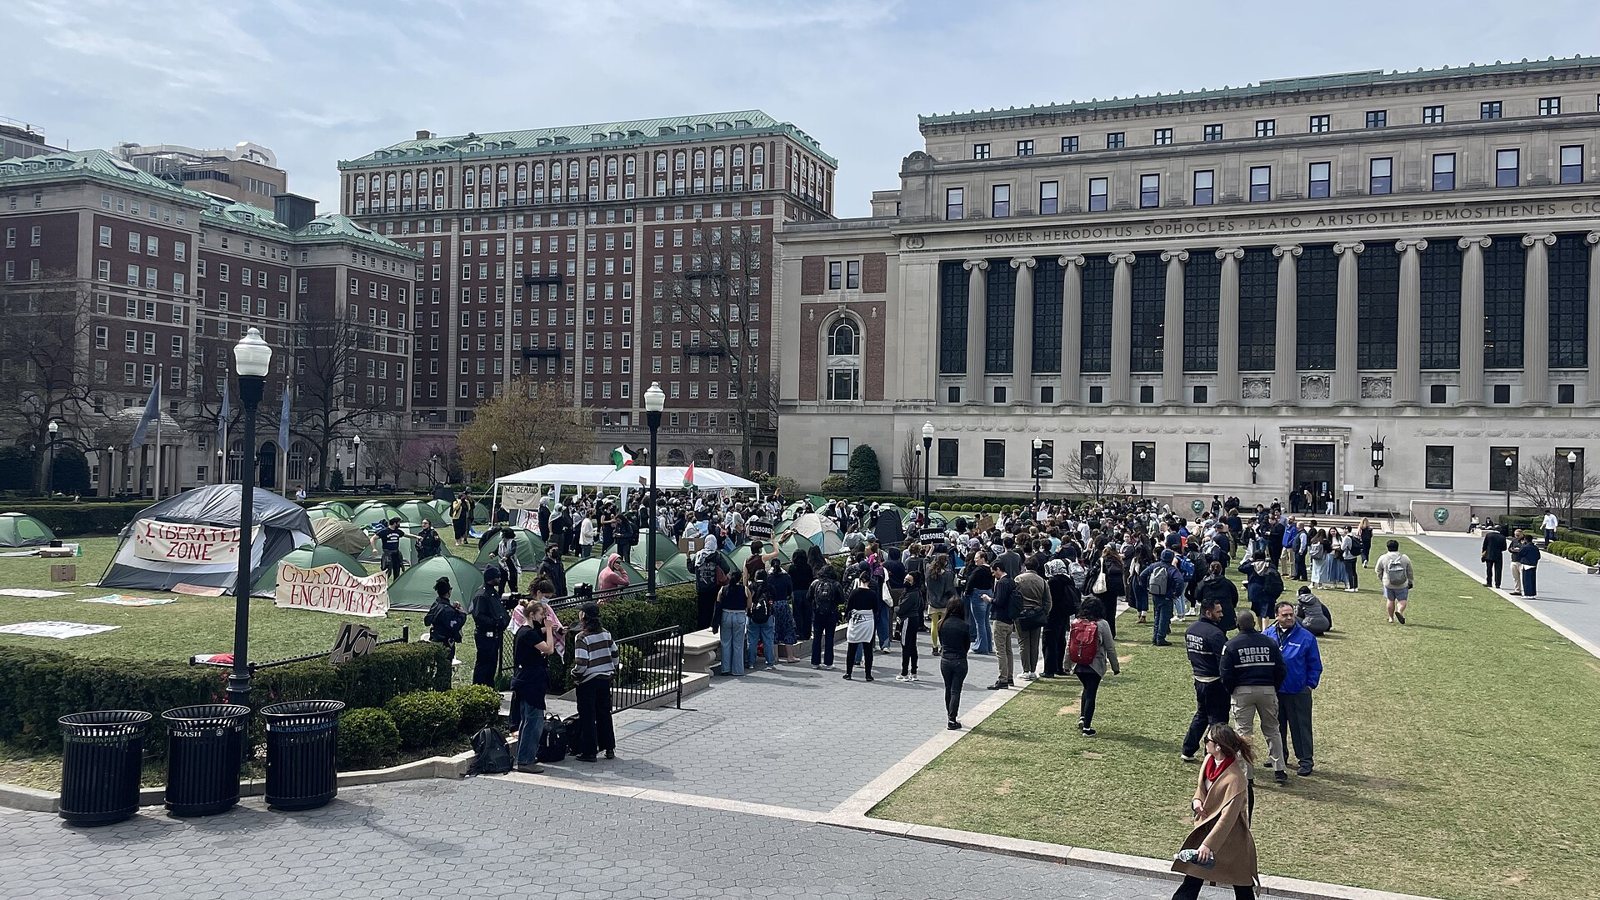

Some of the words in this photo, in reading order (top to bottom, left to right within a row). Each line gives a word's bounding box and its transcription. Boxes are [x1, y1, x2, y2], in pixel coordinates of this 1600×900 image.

[985, 232, 1033, 244] HOMER
[1043, 226, 1132, 241] HERODOTUS
[1144, 221, 1235, 236] SOPHOCLES
[1248, 217, 1302, 231] PLATO
[1316, 211, 1410, 227] ARISTOTLE
[1422, 203, 1556, 221] DEMOSTHENES
[516, 486, 539, 495] DEMAND
[145, 522, 241, 543] LIBERATED
[749, 525, 771, 534] CENSORE
[166, 541, 214, 561] ZONE
[282, 564, 322, 585] GAZA
[289, 584, 379, 614] ENCAMPMENT
[333, 624, 378, 658] NOT
[1238, 646, 1270, 655] PUBLIC
[1240, 655, 1270, 663] SAFETY
[173, 730, 202, 738] TRASH
